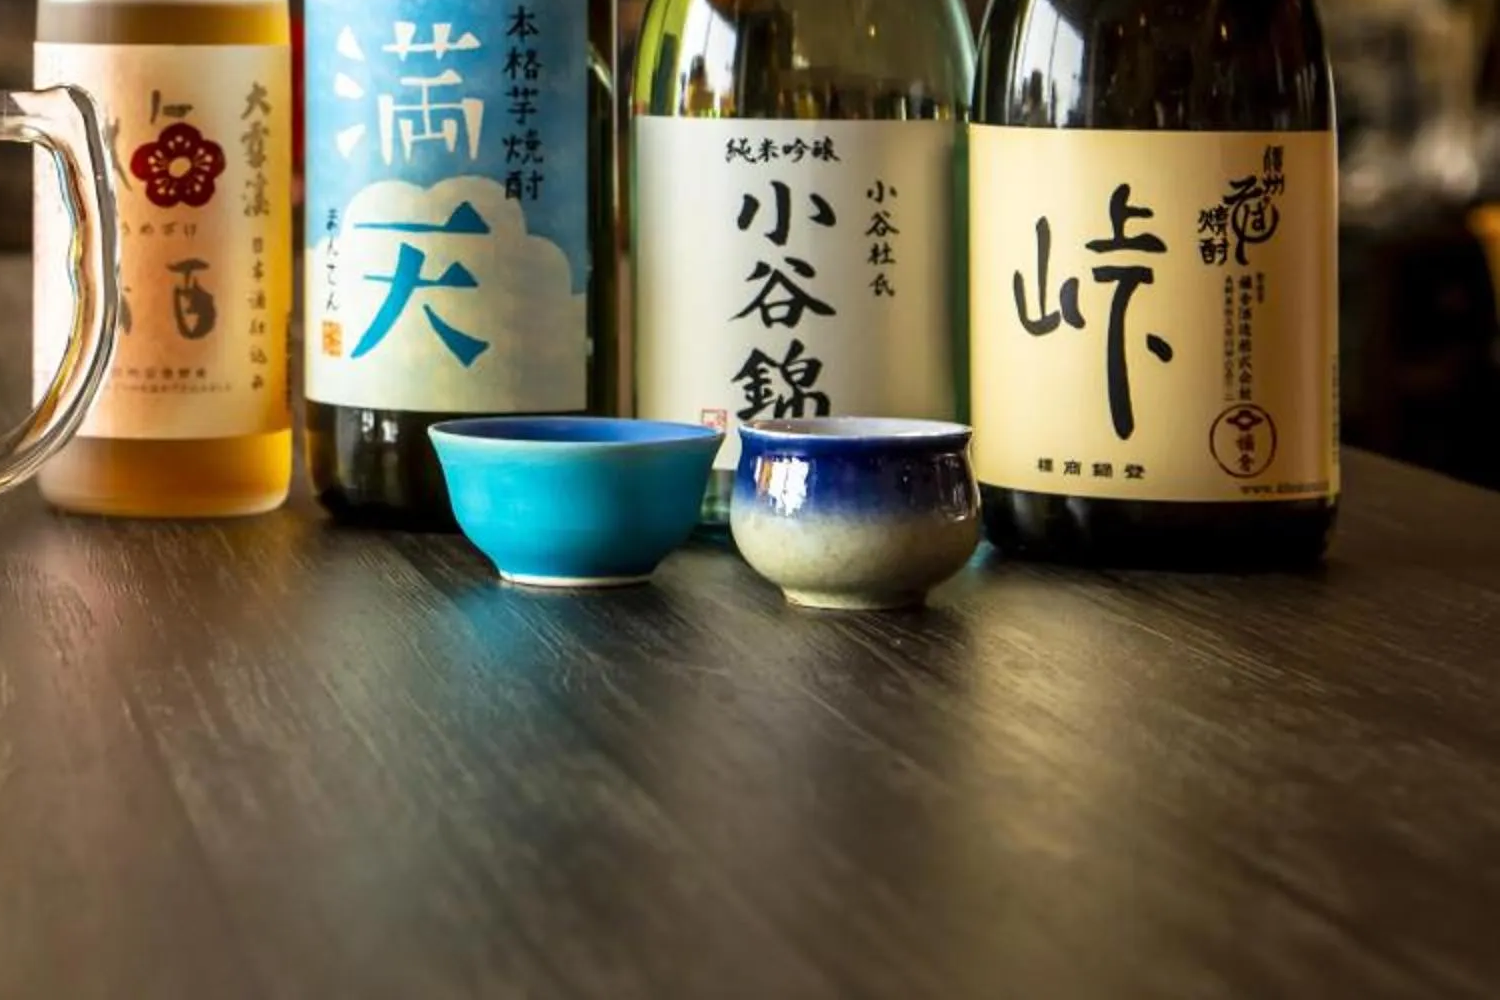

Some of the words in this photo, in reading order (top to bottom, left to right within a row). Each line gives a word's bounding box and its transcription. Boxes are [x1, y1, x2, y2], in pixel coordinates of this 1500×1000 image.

[333, 20, 490, 369] 満天
[502, 5, 544, 201] 本格芋焼酎
[728, 180, 837, 419] 小谷錦
[865, 180, 900, 297] 小谷杜氏
[1012, 183, 1174, 441] 峠
